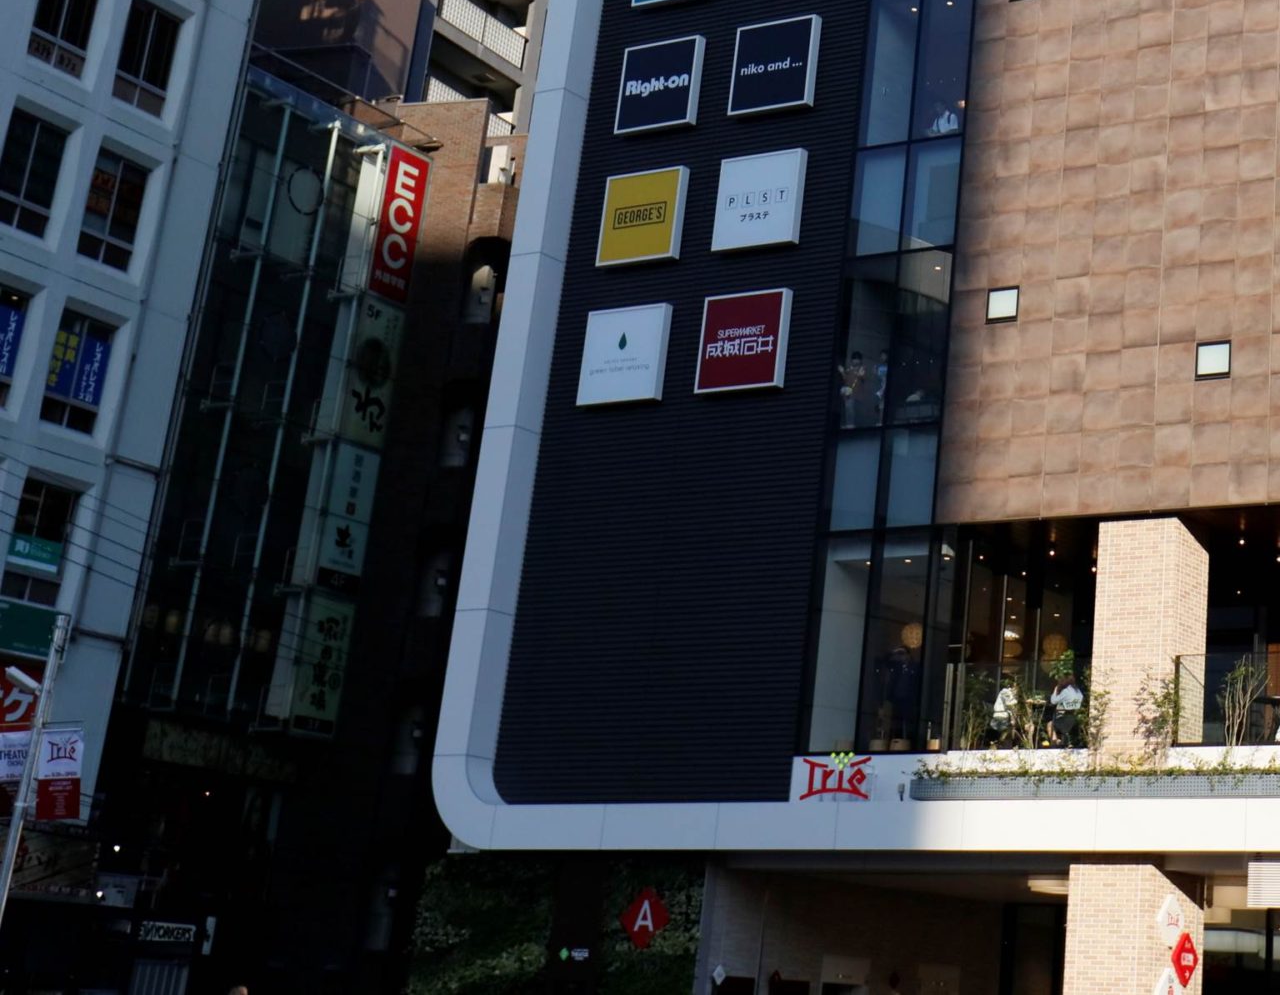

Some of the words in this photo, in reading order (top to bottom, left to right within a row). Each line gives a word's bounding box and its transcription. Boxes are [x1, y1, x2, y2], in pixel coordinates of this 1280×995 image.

[740, 64, 764, 76] niko
[767, 57, 790, 72] and
[625, 73, 689, 97] Right-on
[382, 161, 419, 269] ECC
[617, 206, 663, 225] GEORGE'S
[717, 325, 766, 339] SUPERMARKET
[706, 335, 774, 359] 成城石井
[0, 749, 28, 760] THEATU
[633, 899, 654, 932] A
